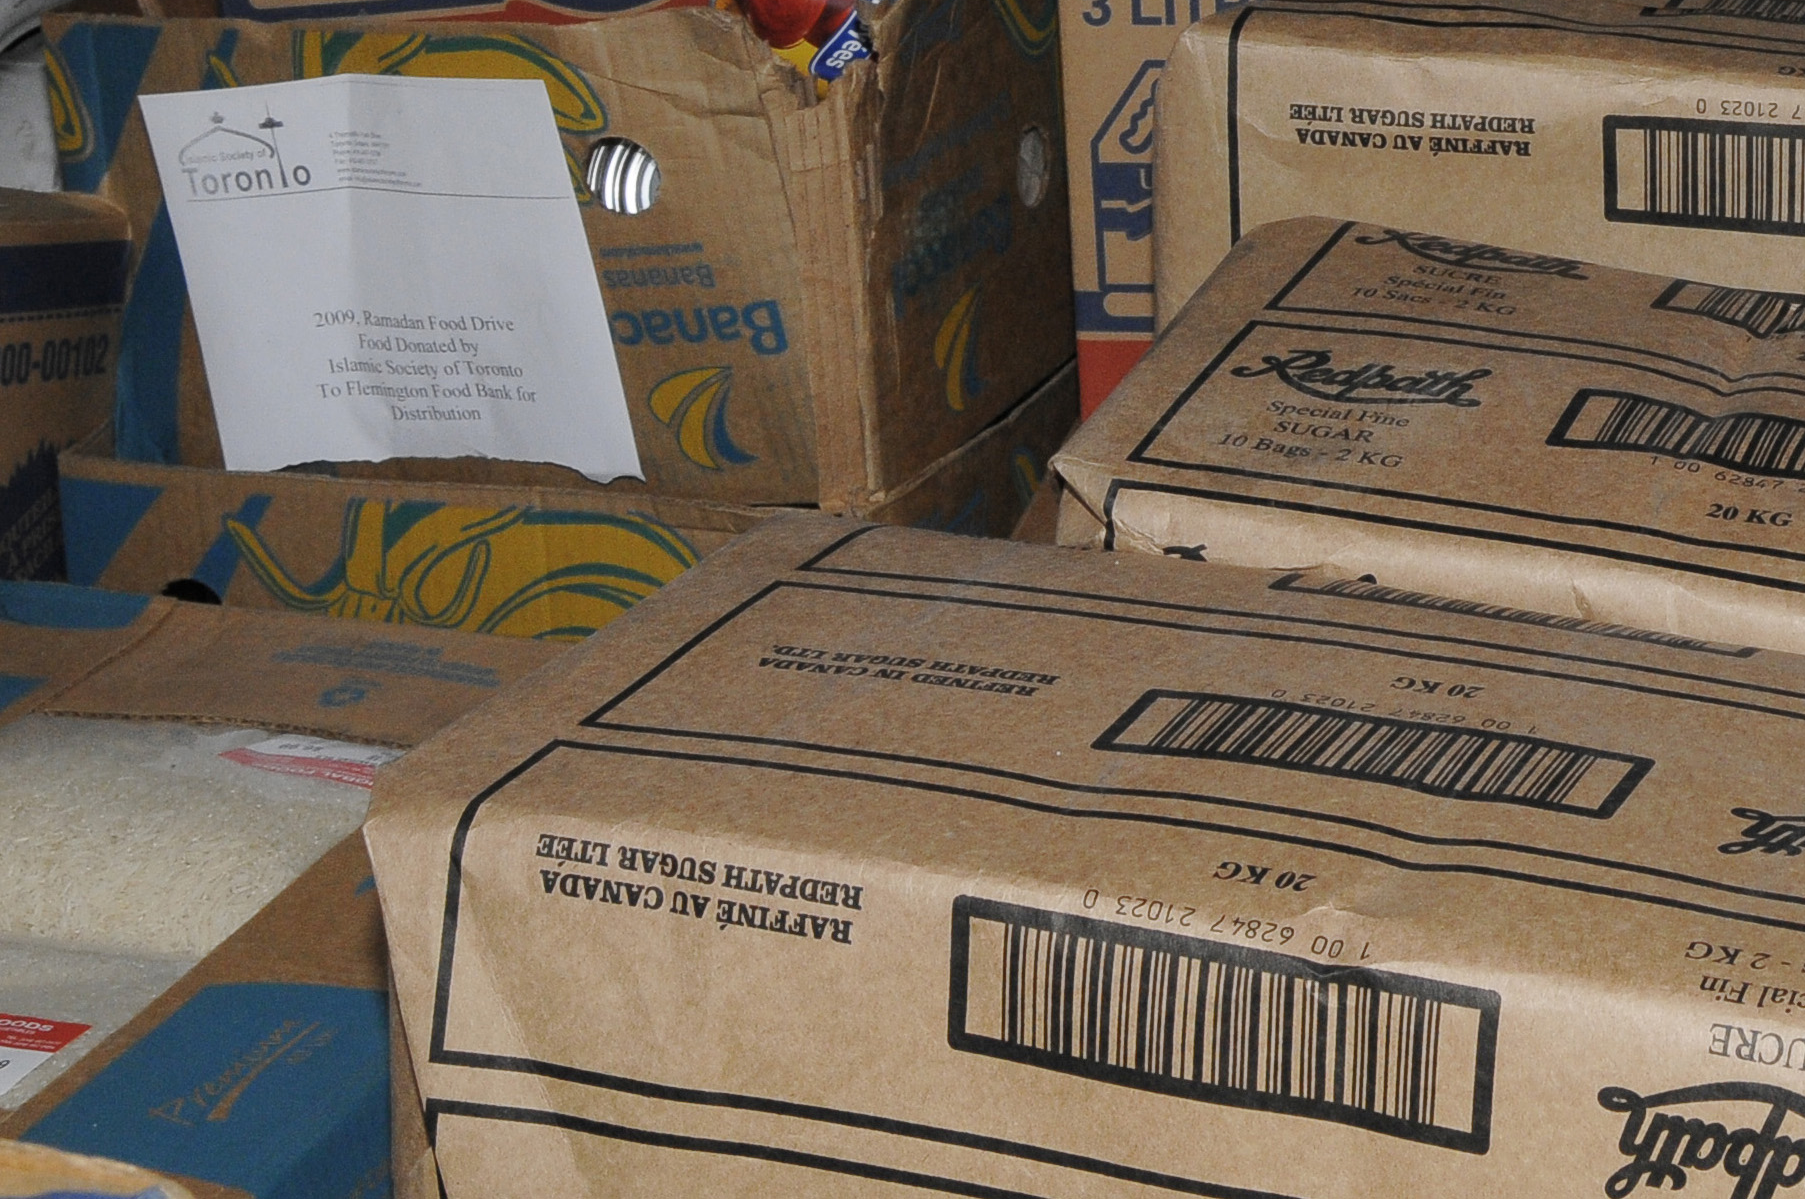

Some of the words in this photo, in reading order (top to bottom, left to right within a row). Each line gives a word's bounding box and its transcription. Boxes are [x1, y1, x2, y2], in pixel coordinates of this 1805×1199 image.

[1289, 103, 1345, 125] LTÉE
[1349, 106, 1425, 129] SUGAR
[1429, 112, 1536, 135] REDPATH
[1295, 128, 1387, 151] CANADA
[1391, 134, 1422, 151] AU
[1429, 136, 1532, 159] RAFFINÉ
[602, 264, 716, 290] Bananas
[363, 310, 425, 330] Ramadan
[428, 315, 467, 331] Food
[471, 315, 515, 332] Drive
[609, 298, 790, 357] Banac
[358, 333, 392, 351] Food
[395, 336, 456, 353] Donated
[460, 339, 479, 357] by
[328, 357, 382, 374] Islamic
[386, 360, 438, 380] Society
[443, 361, 462, 377] of
[465, 361, 523, 378] Toronto
[1230, 348, 1493, 408] Redpath
[316, 383, 342, 400] To
[346, 381, 428, 401] Flemington
[431, 383, 472, 399] Food
[475, 382, 513, 401] Bank
[516, 387, 538, 402] for
[391, 405, 482, 421] Distribution
[1265, 400, 1356, 424] Special
[1360, 409, 1410, 429] Fine
[1273, 420, 1375, 444] SUGAR
[1705, 502, 1740, 522] 20
[1743, 506, 1794, 528] KG
[535, 833, 612, 868] LTÉE
[617, 845, 718, 886] SUGAR
[1212, 860, 1269, 886] KG
[540, 868, 664, 911] CANADA
[721, 863, 865, 911] REDPATH
[1273, 872, 1318, 892] 20
[668, 889, 711, 919] AU
[1082, 887, 1100, 910] 0
[715, 898, 854, 946] RAFFINÉ
[1115, 894, 1198, 928] 21023
[1209, 913, 1296, 946] 62847
[1310, 935, 1344, 958] 00
[1360, 942, 1371, 961] 1
[1699, 974, 1748, 1005] Fin
